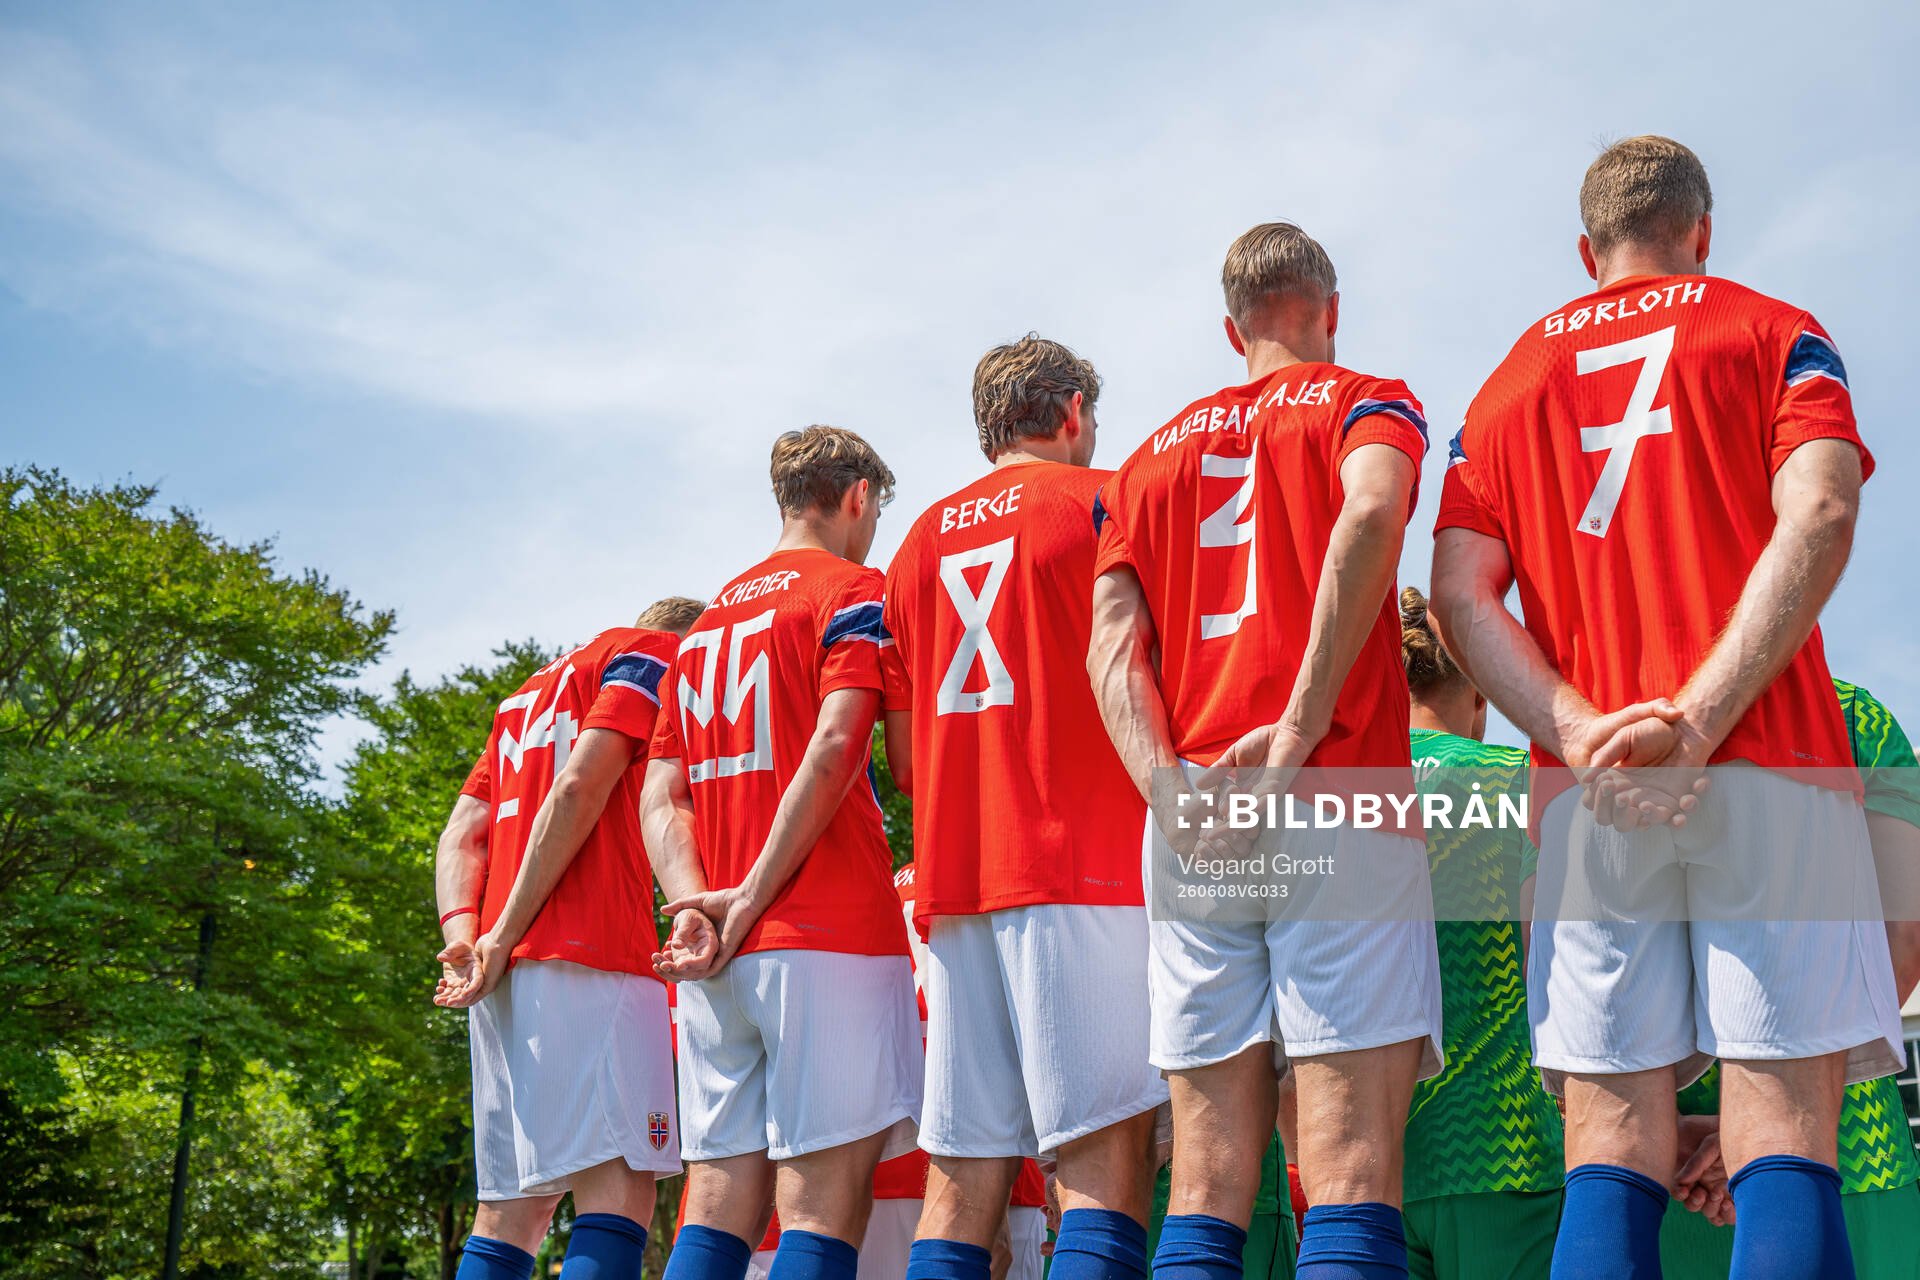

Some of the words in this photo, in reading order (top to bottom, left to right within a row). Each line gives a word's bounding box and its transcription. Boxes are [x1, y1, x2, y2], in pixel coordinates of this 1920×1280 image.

[1544, 282, 1707, 338] SØRLOTH
[1265, 379, 1337, 408] AJER
[1576, 325, 1676, 538] 7
[940, 483, 1023, 535] BERGE
[1200, 432, 1258, 640] 3
[704, 570, 801, 612] LCHENER
[937, 536, 1014, 716] 8
[677, 609, 775, 784] 25
